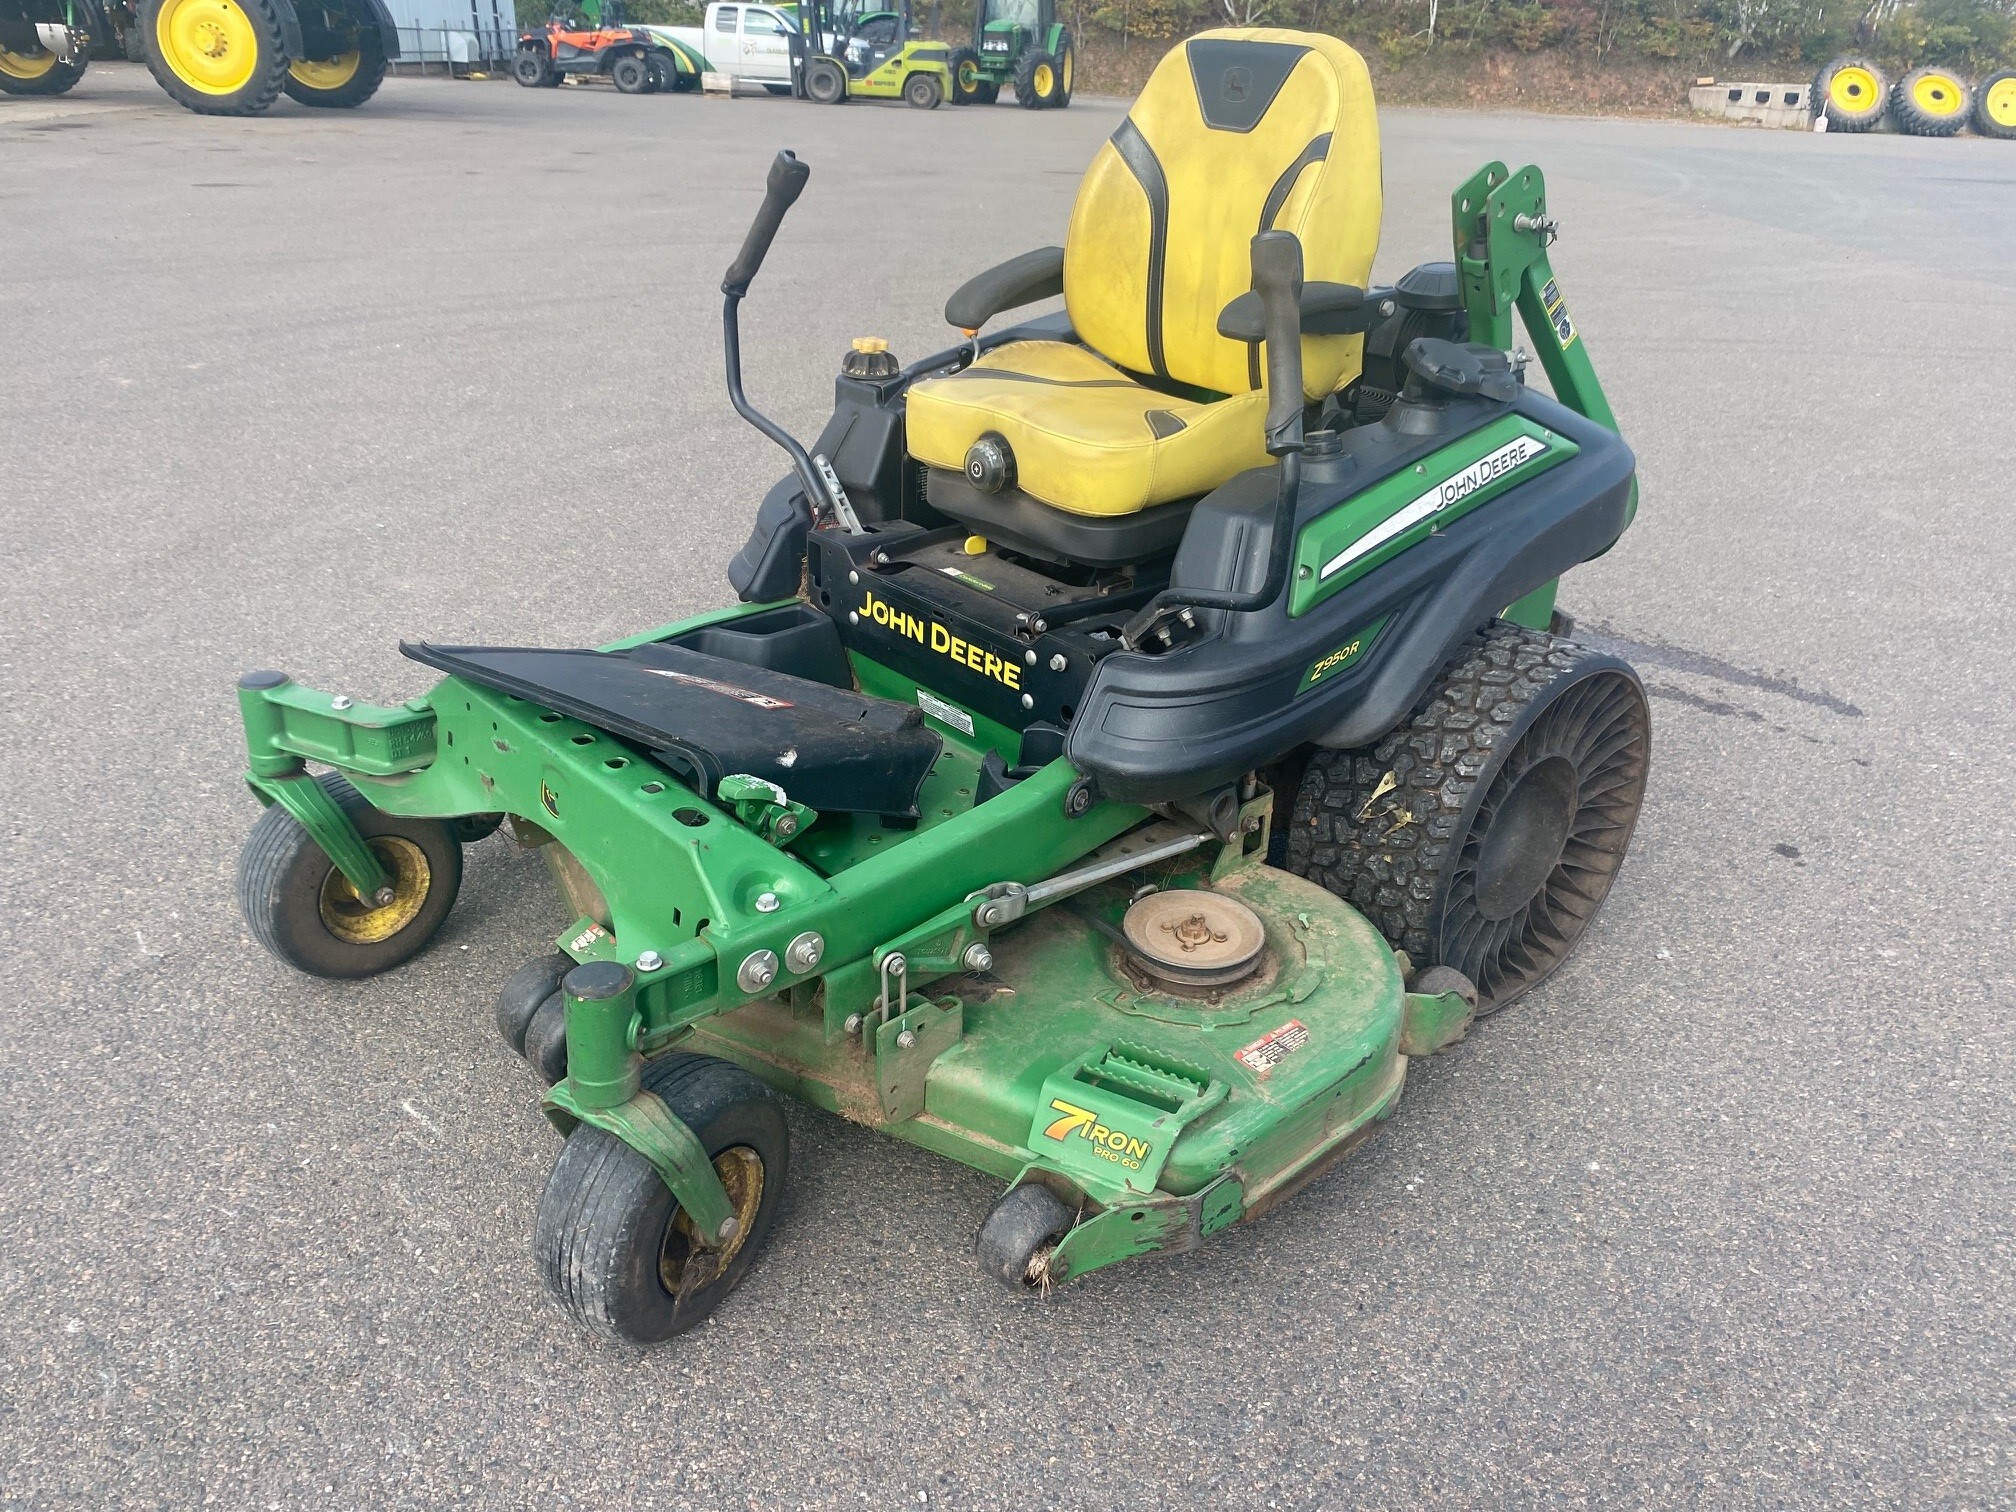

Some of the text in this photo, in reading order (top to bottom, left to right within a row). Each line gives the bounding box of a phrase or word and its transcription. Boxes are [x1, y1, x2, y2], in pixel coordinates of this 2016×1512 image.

[1437, 442, 1528, 510] JOHN DEERE
[858, 591, 1022, 691] JOHN DEERE
[1310, 640, 1360, 682] Z950R
[1093, 1146, 1141, 1171] PRO 60
